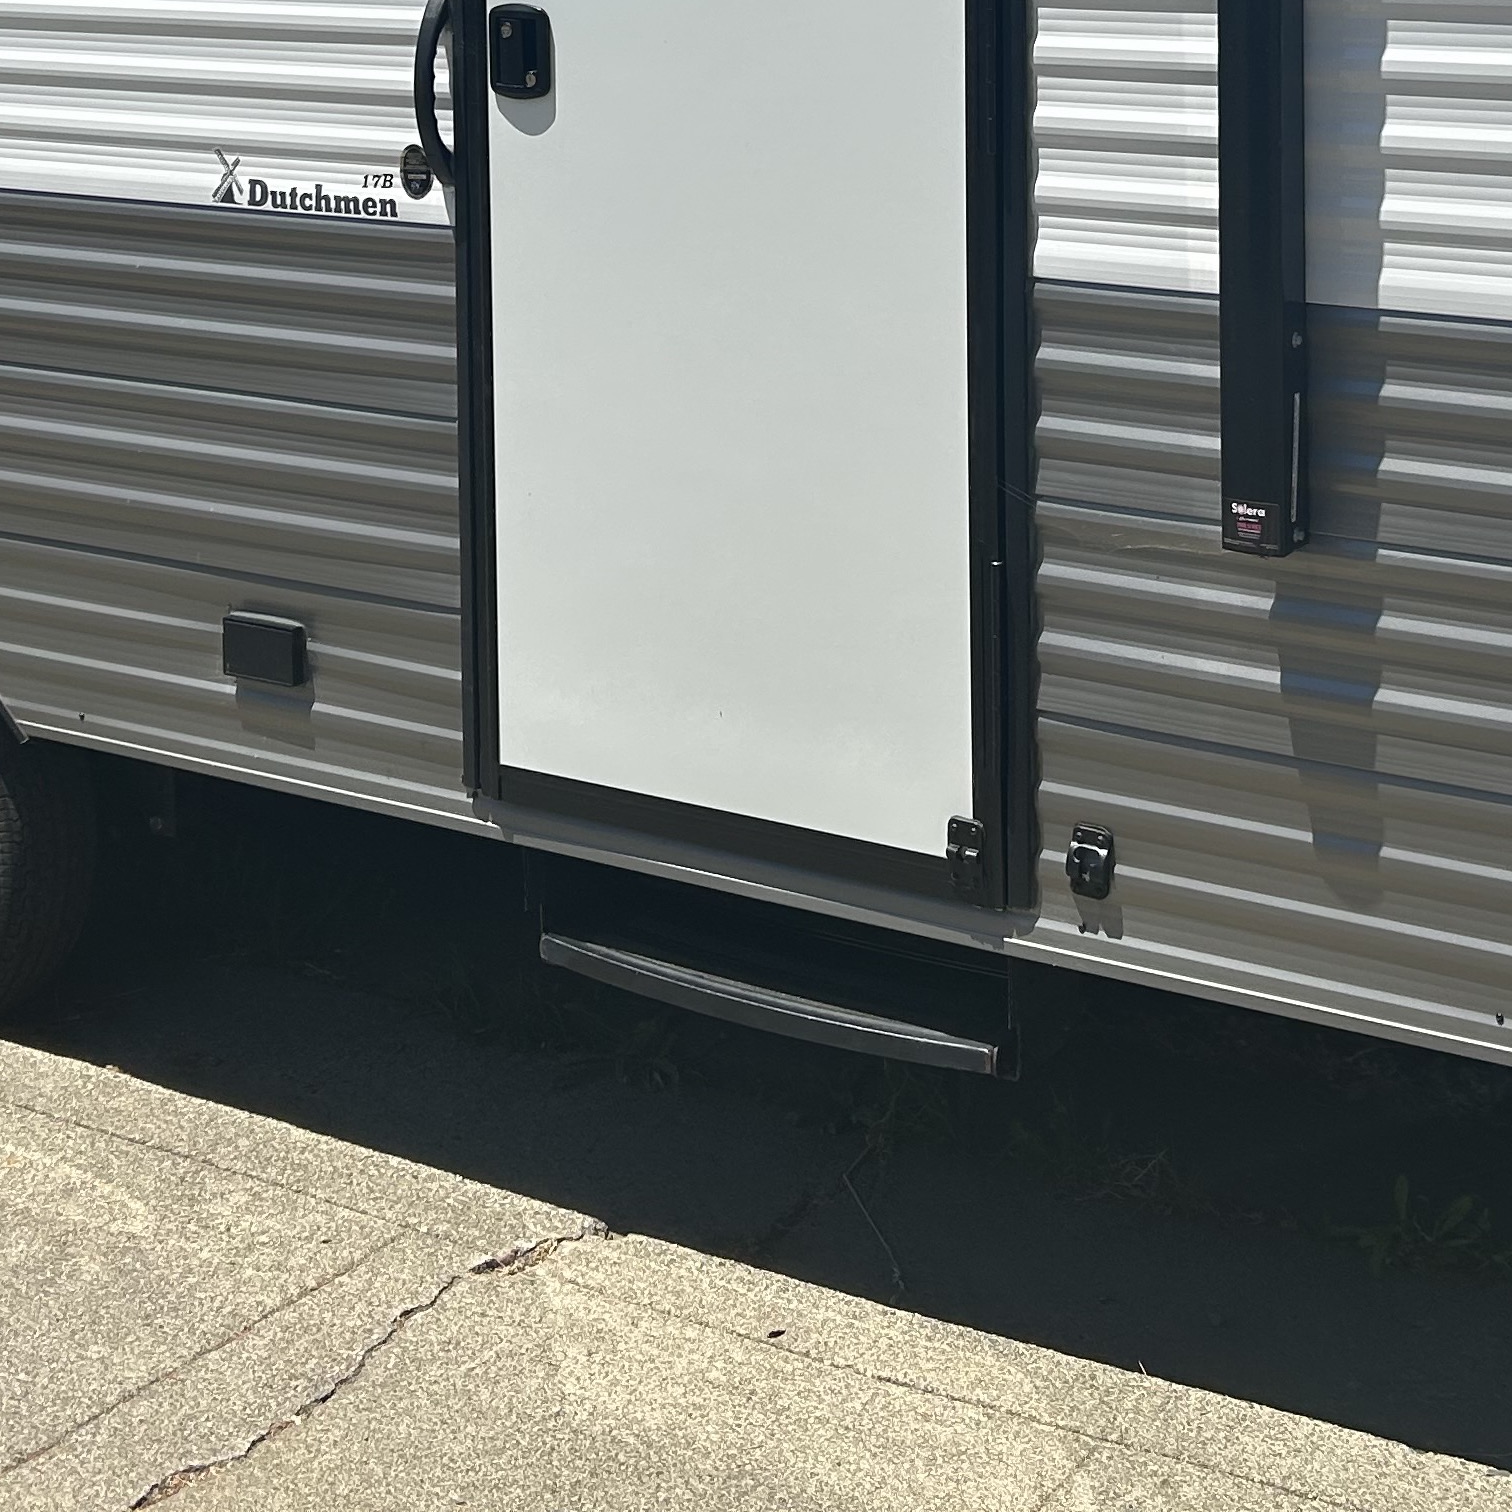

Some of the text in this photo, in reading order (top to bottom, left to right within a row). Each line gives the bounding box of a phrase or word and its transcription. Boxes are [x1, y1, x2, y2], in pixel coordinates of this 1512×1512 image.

[361, 173, 394, 189] 17B
[248, 179, 398, 218] Dutchmen
[1231, 502, 1266, 517] Solera
